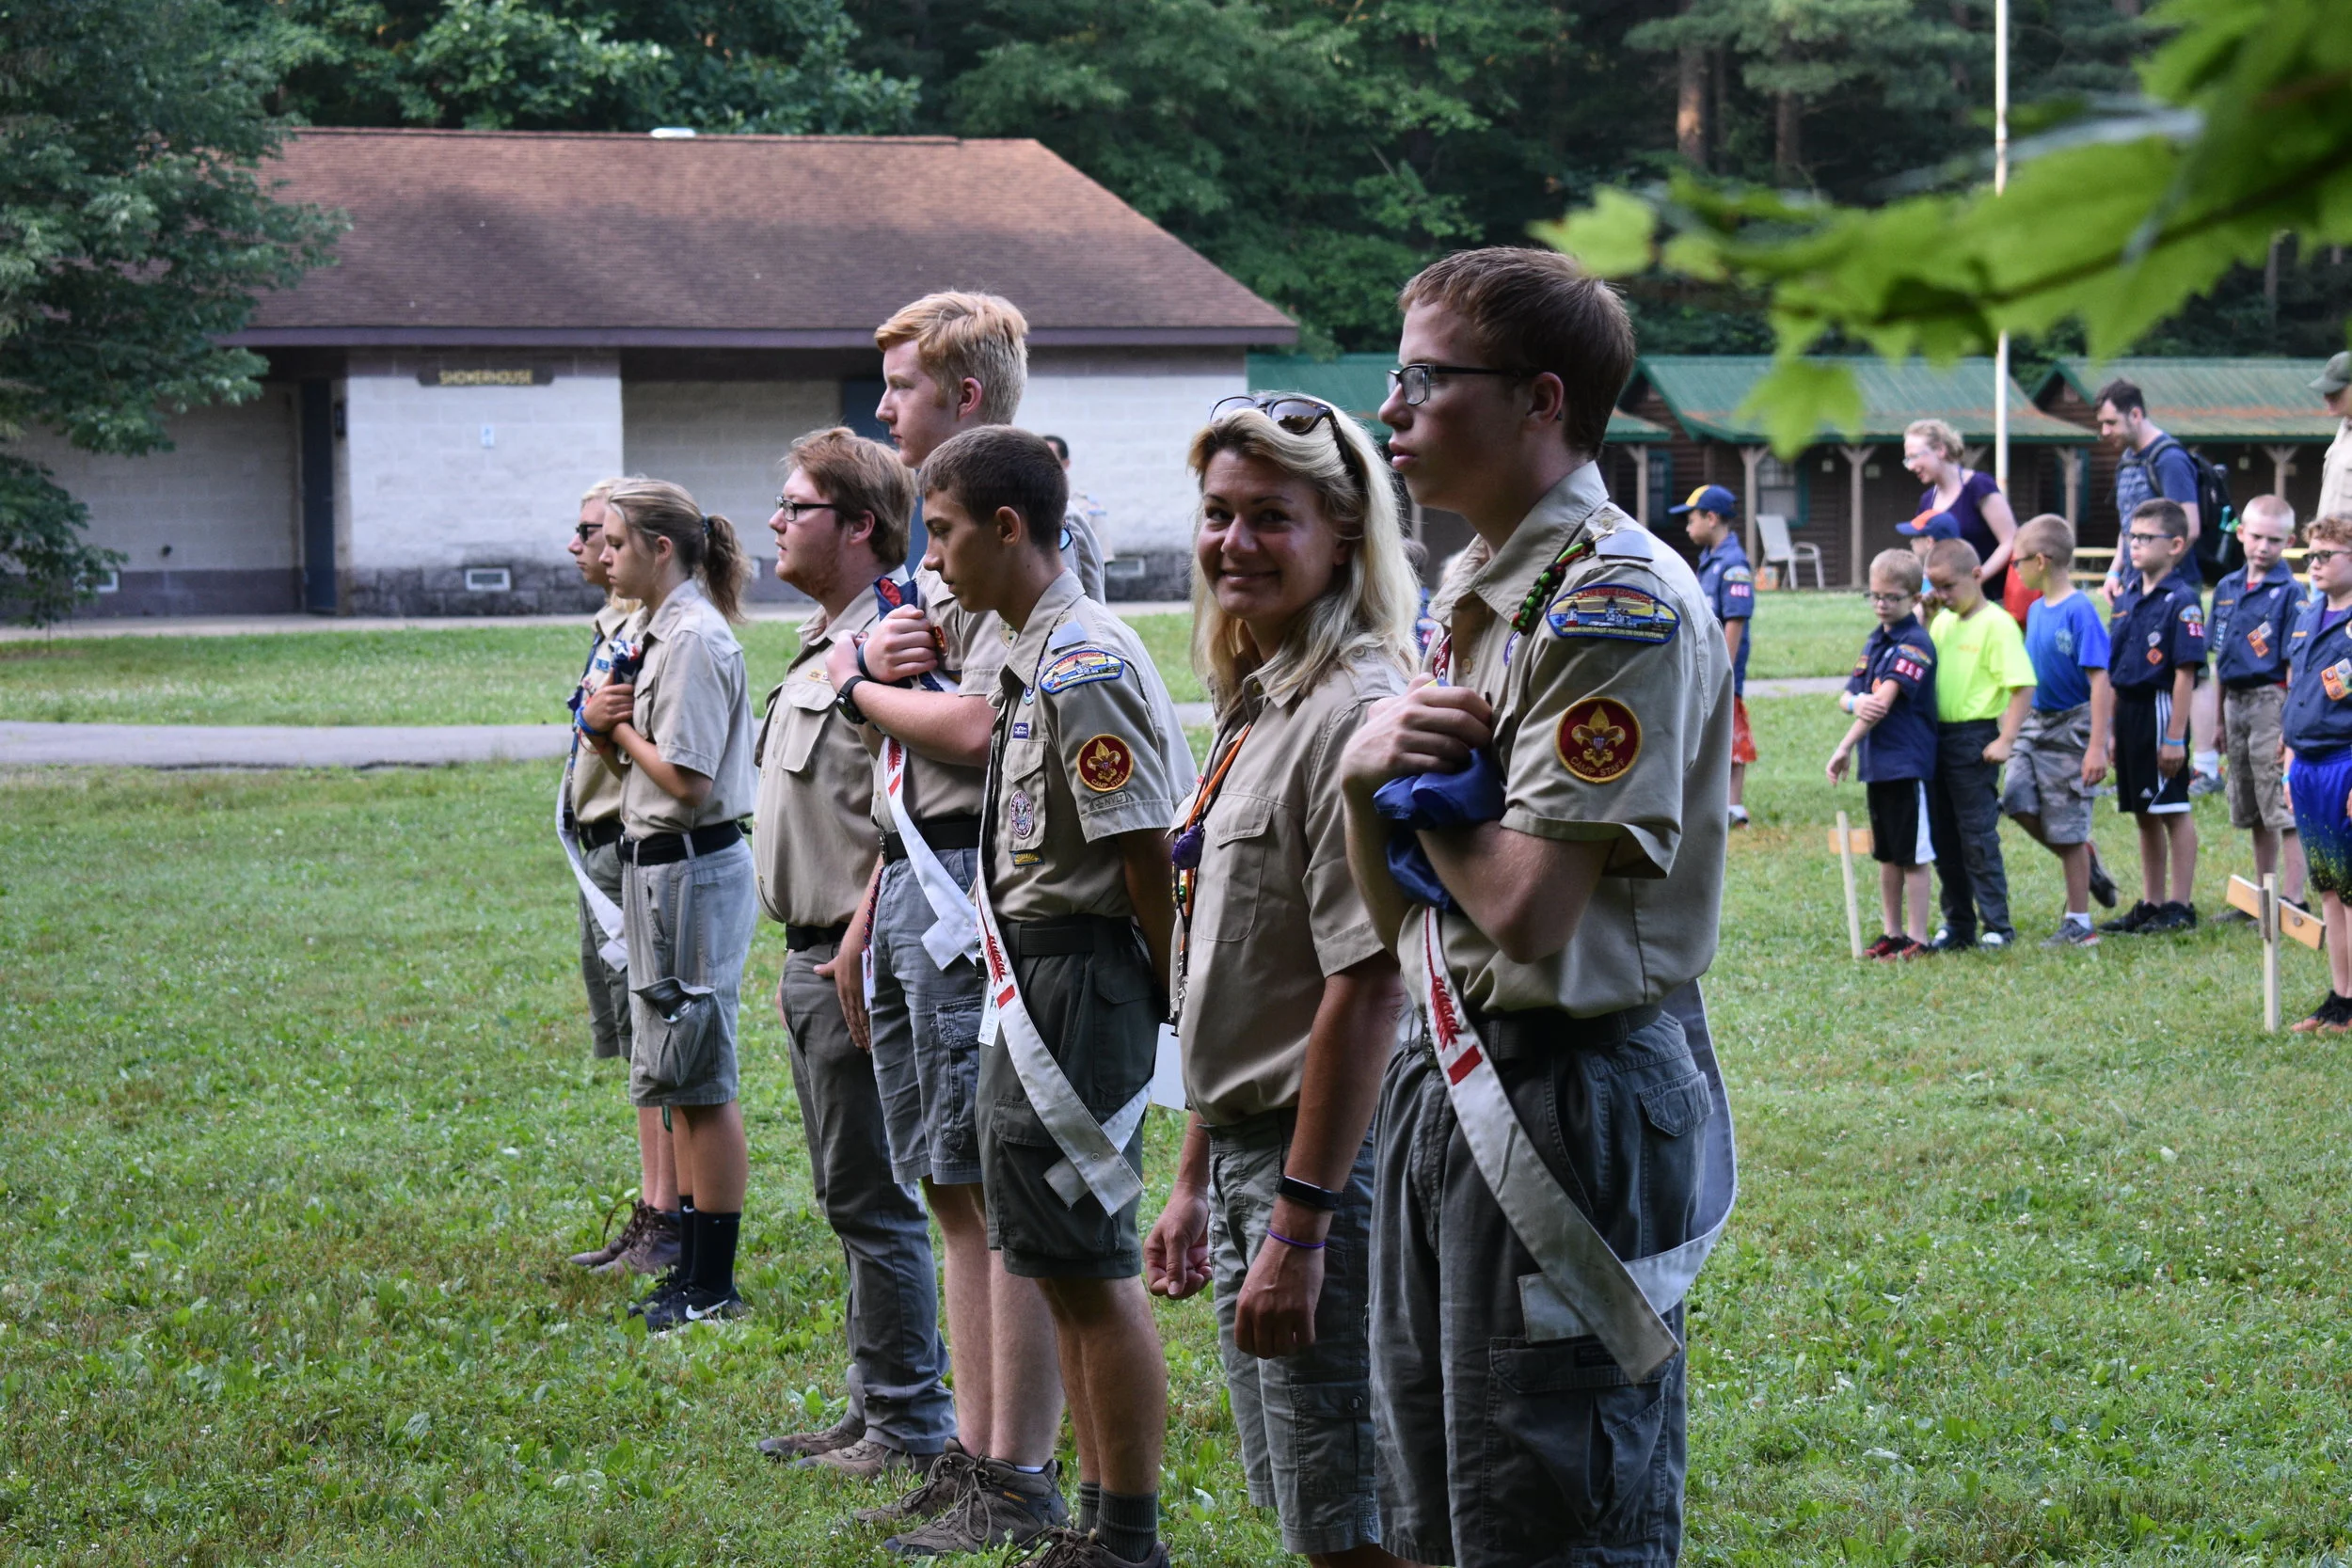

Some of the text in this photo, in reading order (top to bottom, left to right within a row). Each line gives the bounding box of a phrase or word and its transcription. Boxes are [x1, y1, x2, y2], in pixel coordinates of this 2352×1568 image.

[1598, 587, 1617, 596] ERIE
[1618, 588, 1652, 605] COUNCIL
[1570, 756, 1625, 776] CAMP STAFF
[1091, 770, 1125, 788] CAMP STAFF
